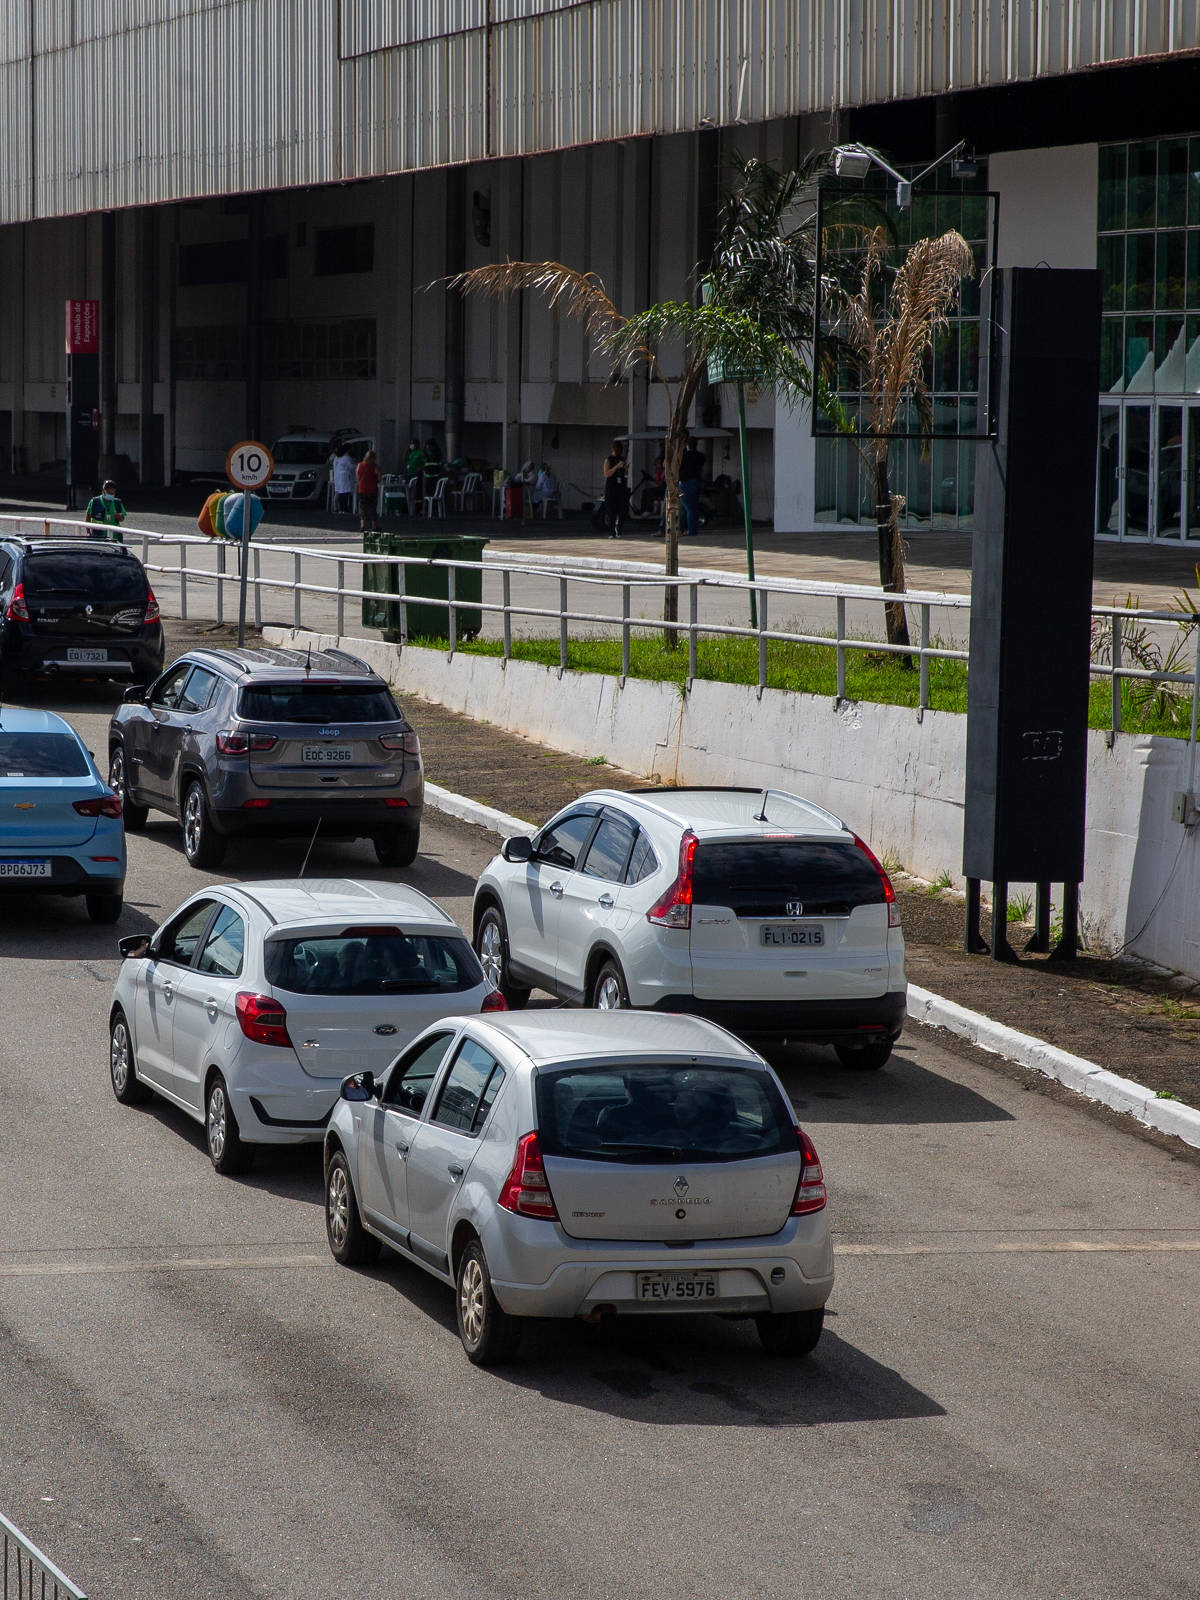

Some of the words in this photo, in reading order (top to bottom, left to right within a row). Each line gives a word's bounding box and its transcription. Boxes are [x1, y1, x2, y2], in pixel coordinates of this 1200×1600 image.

[238, 453, 262, 472] 10
[319, 728, 340, 737] Jeep
[0, 864, 46, 876] BPQ6J73
